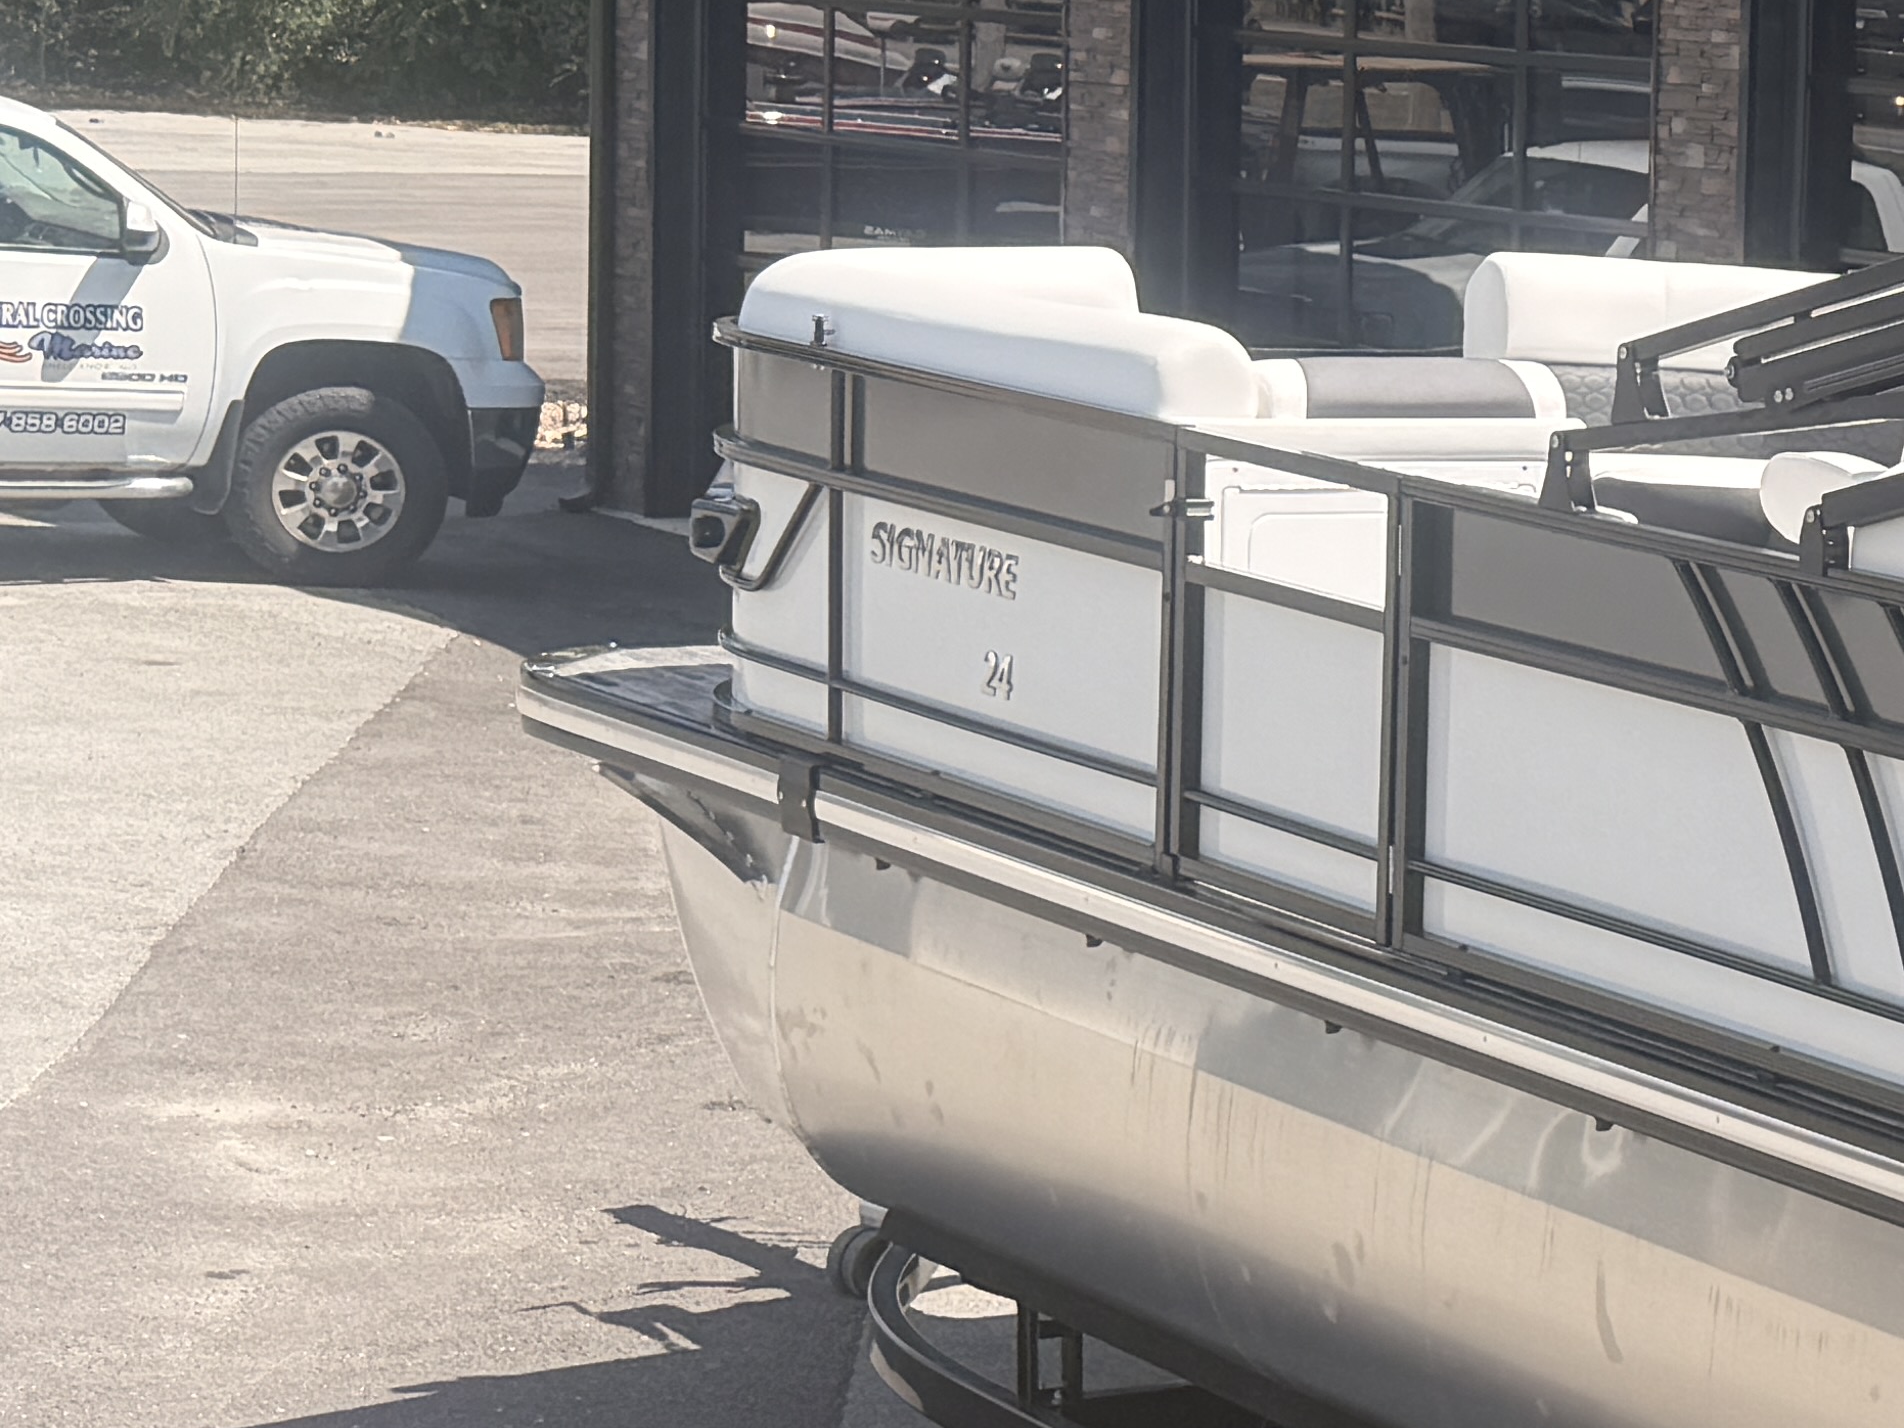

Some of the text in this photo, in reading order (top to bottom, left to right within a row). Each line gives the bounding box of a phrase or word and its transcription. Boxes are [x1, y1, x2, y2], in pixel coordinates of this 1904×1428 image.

[0, 302, 144, 332] RAL CROSSING
[28, 331, 144, 361] Marine
[870, 521, 1020, 601] SIGNATURE
[981, 649, 1014, 701] 24
